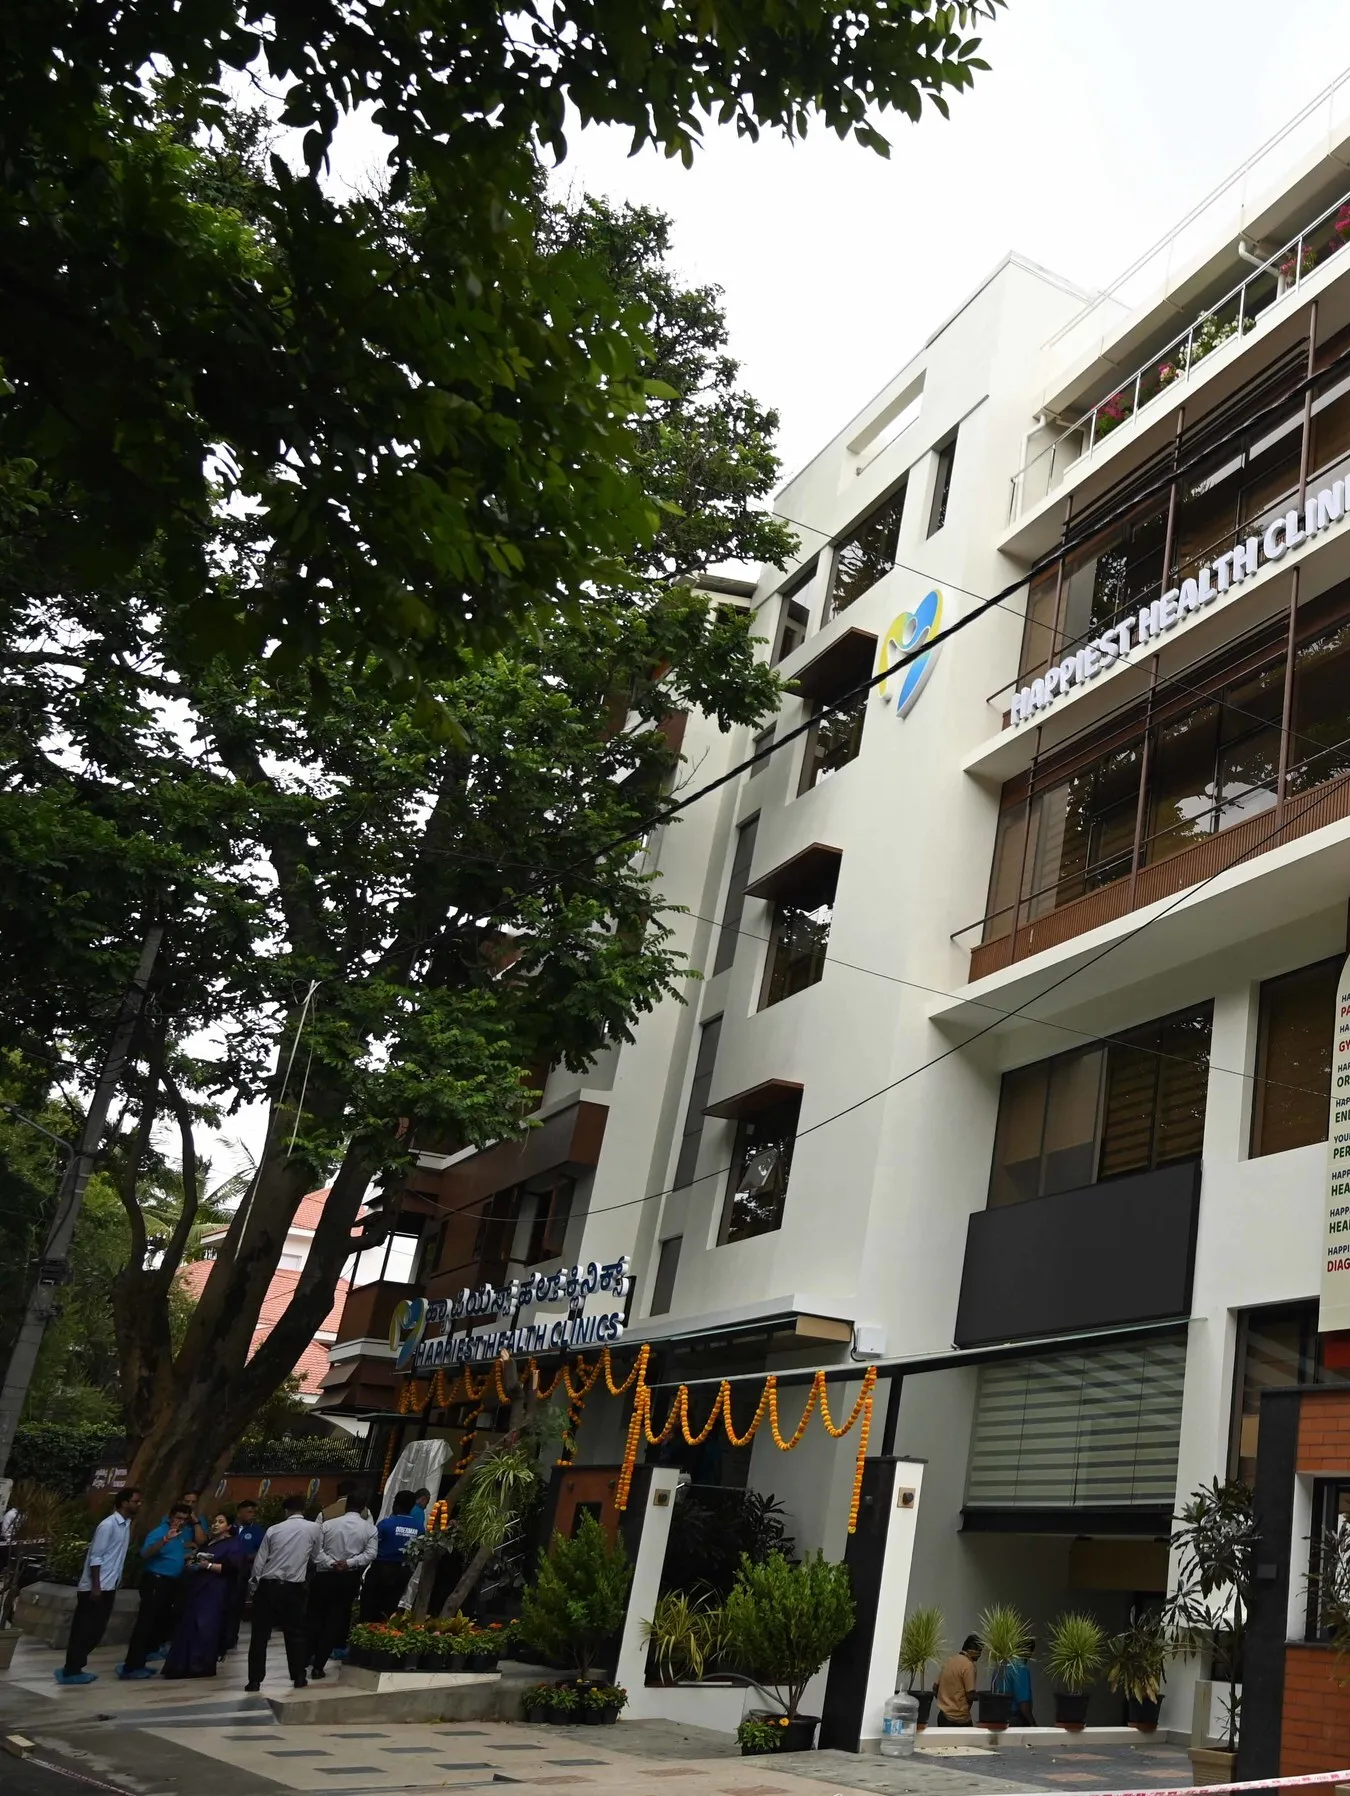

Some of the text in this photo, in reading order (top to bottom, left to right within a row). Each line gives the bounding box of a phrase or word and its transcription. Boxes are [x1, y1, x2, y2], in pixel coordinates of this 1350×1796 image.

[1010, 617, 1136, 726] HAPPIEST
[1138, 537, 1258, 643] HEALTH
[416, 1312, 625, 1366] HAPPIEST HEALTH CLINICS
